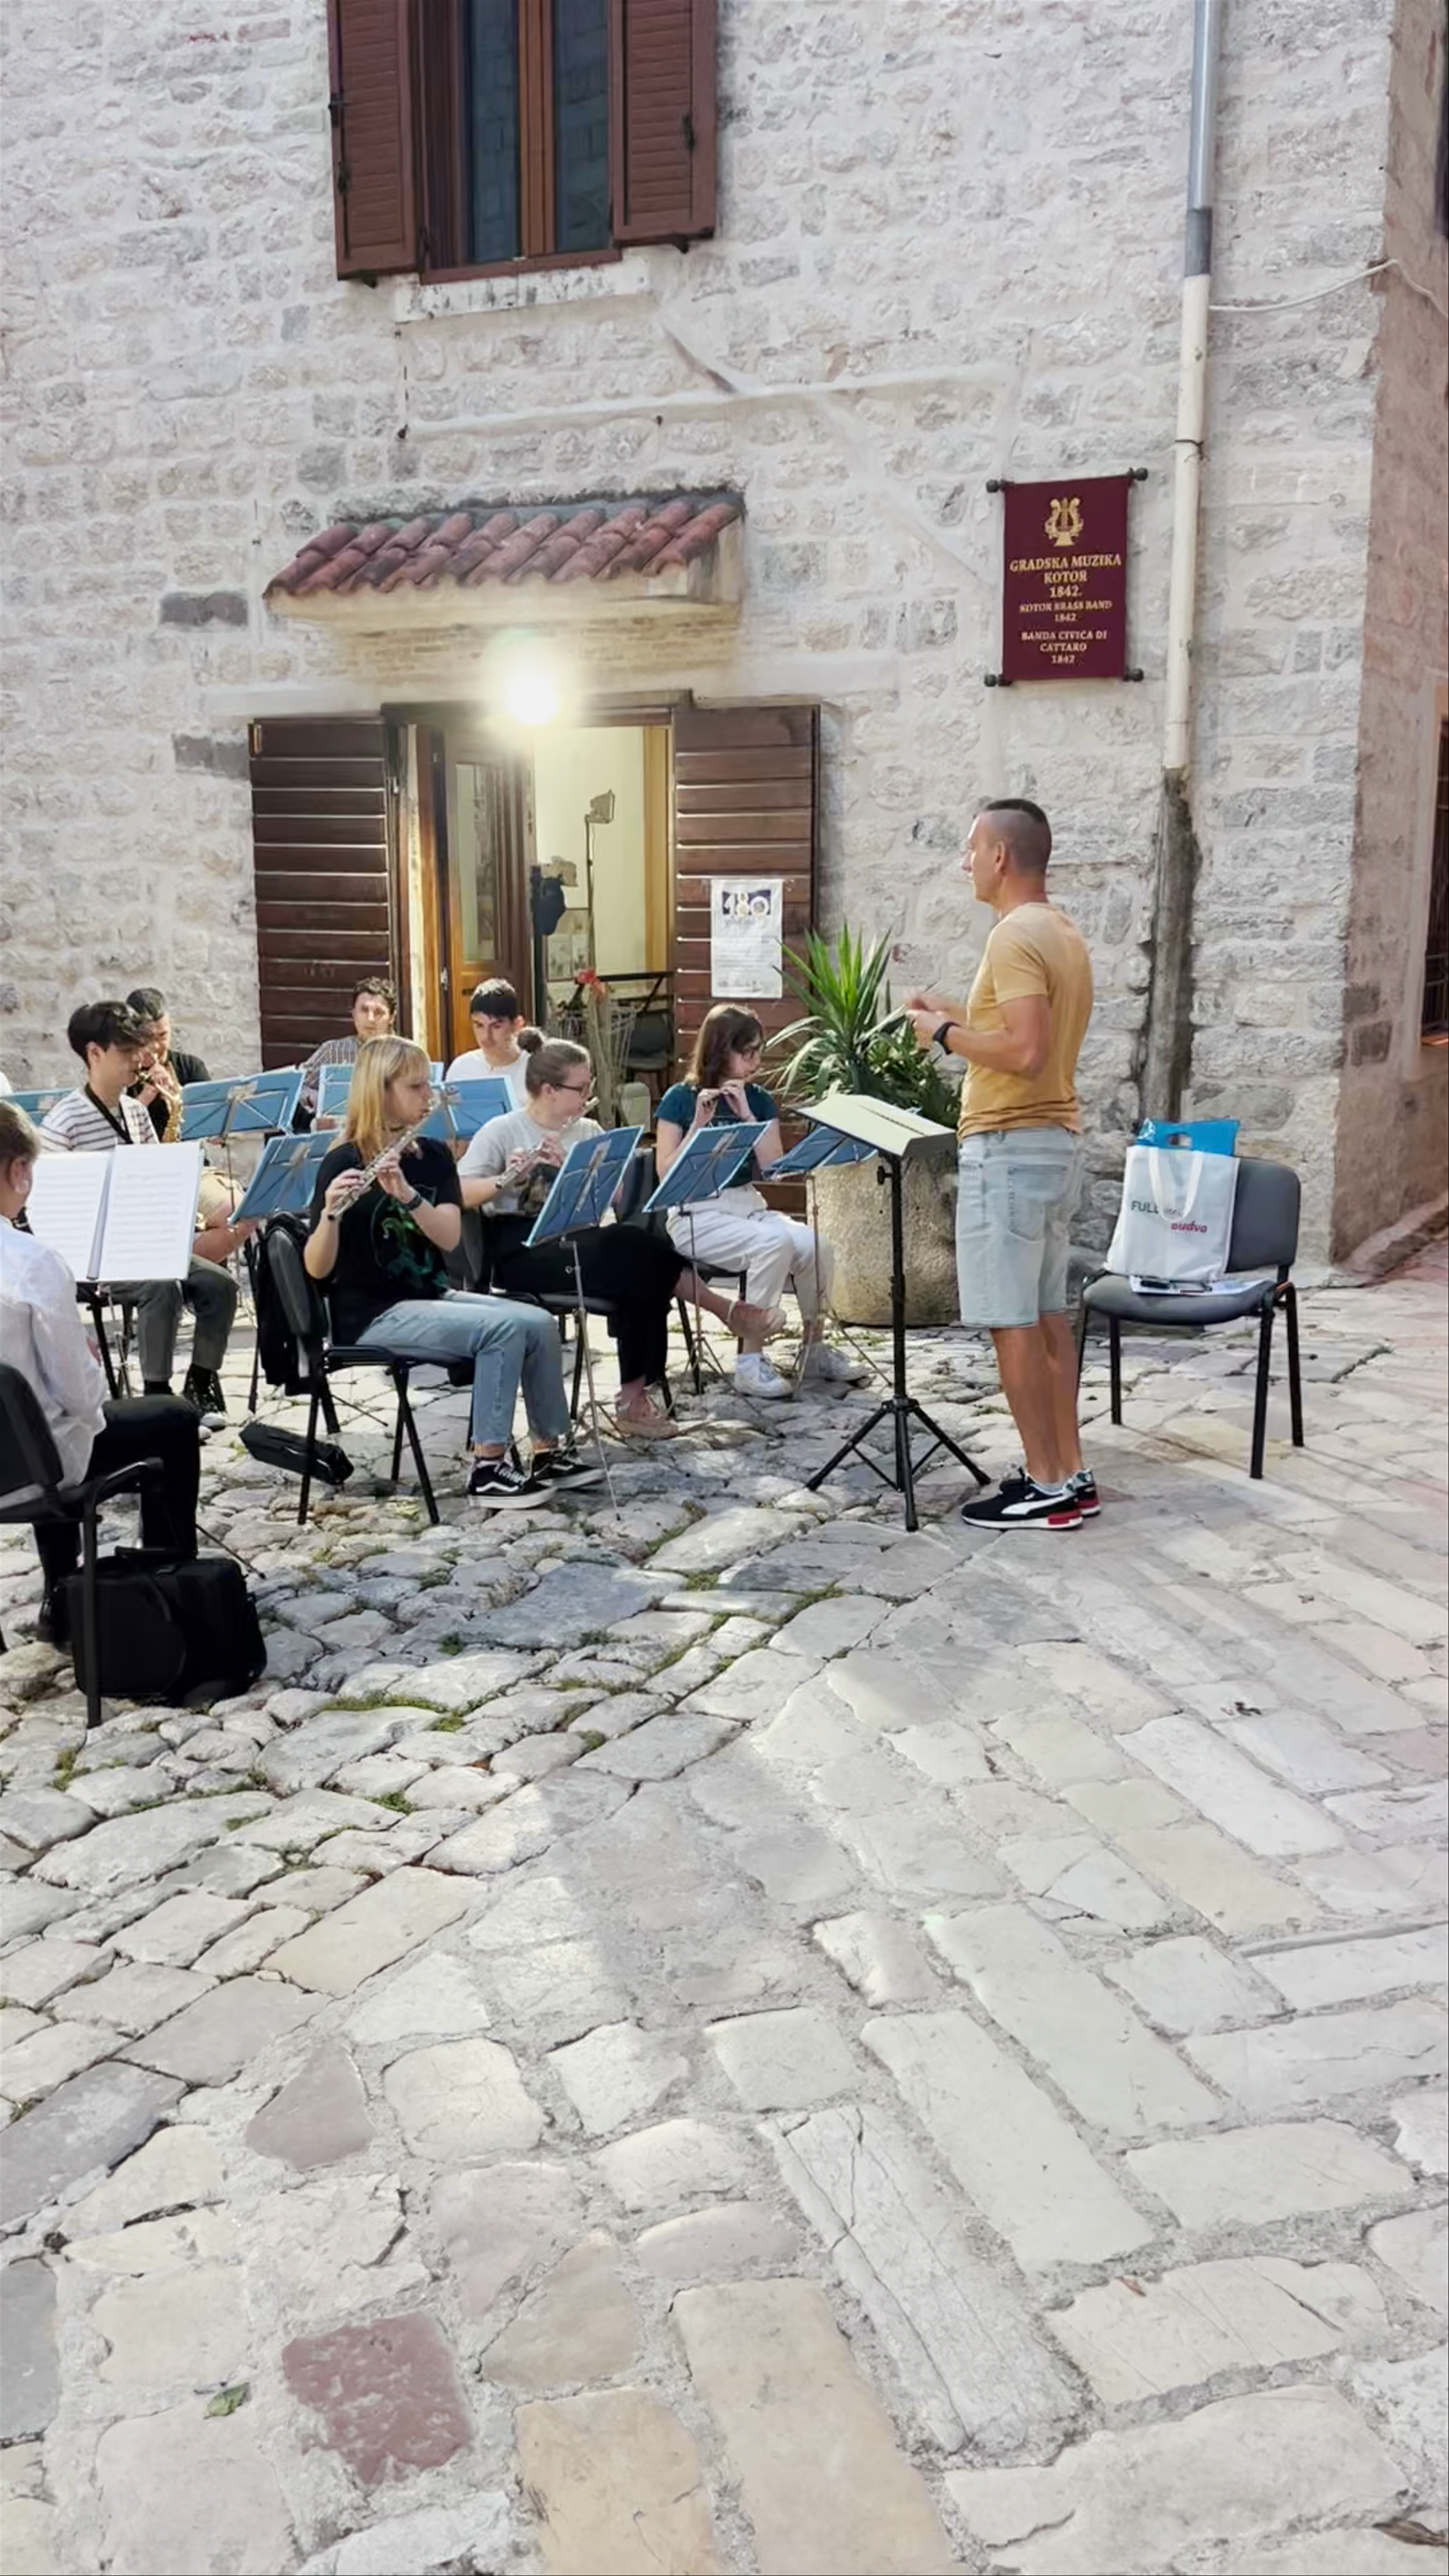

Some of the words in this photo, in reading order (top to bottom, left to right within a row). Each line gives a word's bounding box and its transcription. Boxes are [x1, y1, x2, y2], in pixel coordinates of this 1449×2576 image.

[1009, 557, 1068, 571] GRADSKA
[1071, 554, 1122, 567] MUZIKA
[1044, 570, 1088, 584] KOTOR
[1049, 585, 1082, 598] 1842.
[1019, 603, 1052, 612] KOTOR
[1085, 600, 1112, 610] BAND
[1021, 631, 1056, 641] BANDA
[1058, 630, 1093, 640] CIVICA
[1095, 630, 1107, 640] DI
[1040, 643, 1087, 652] CATTARO
